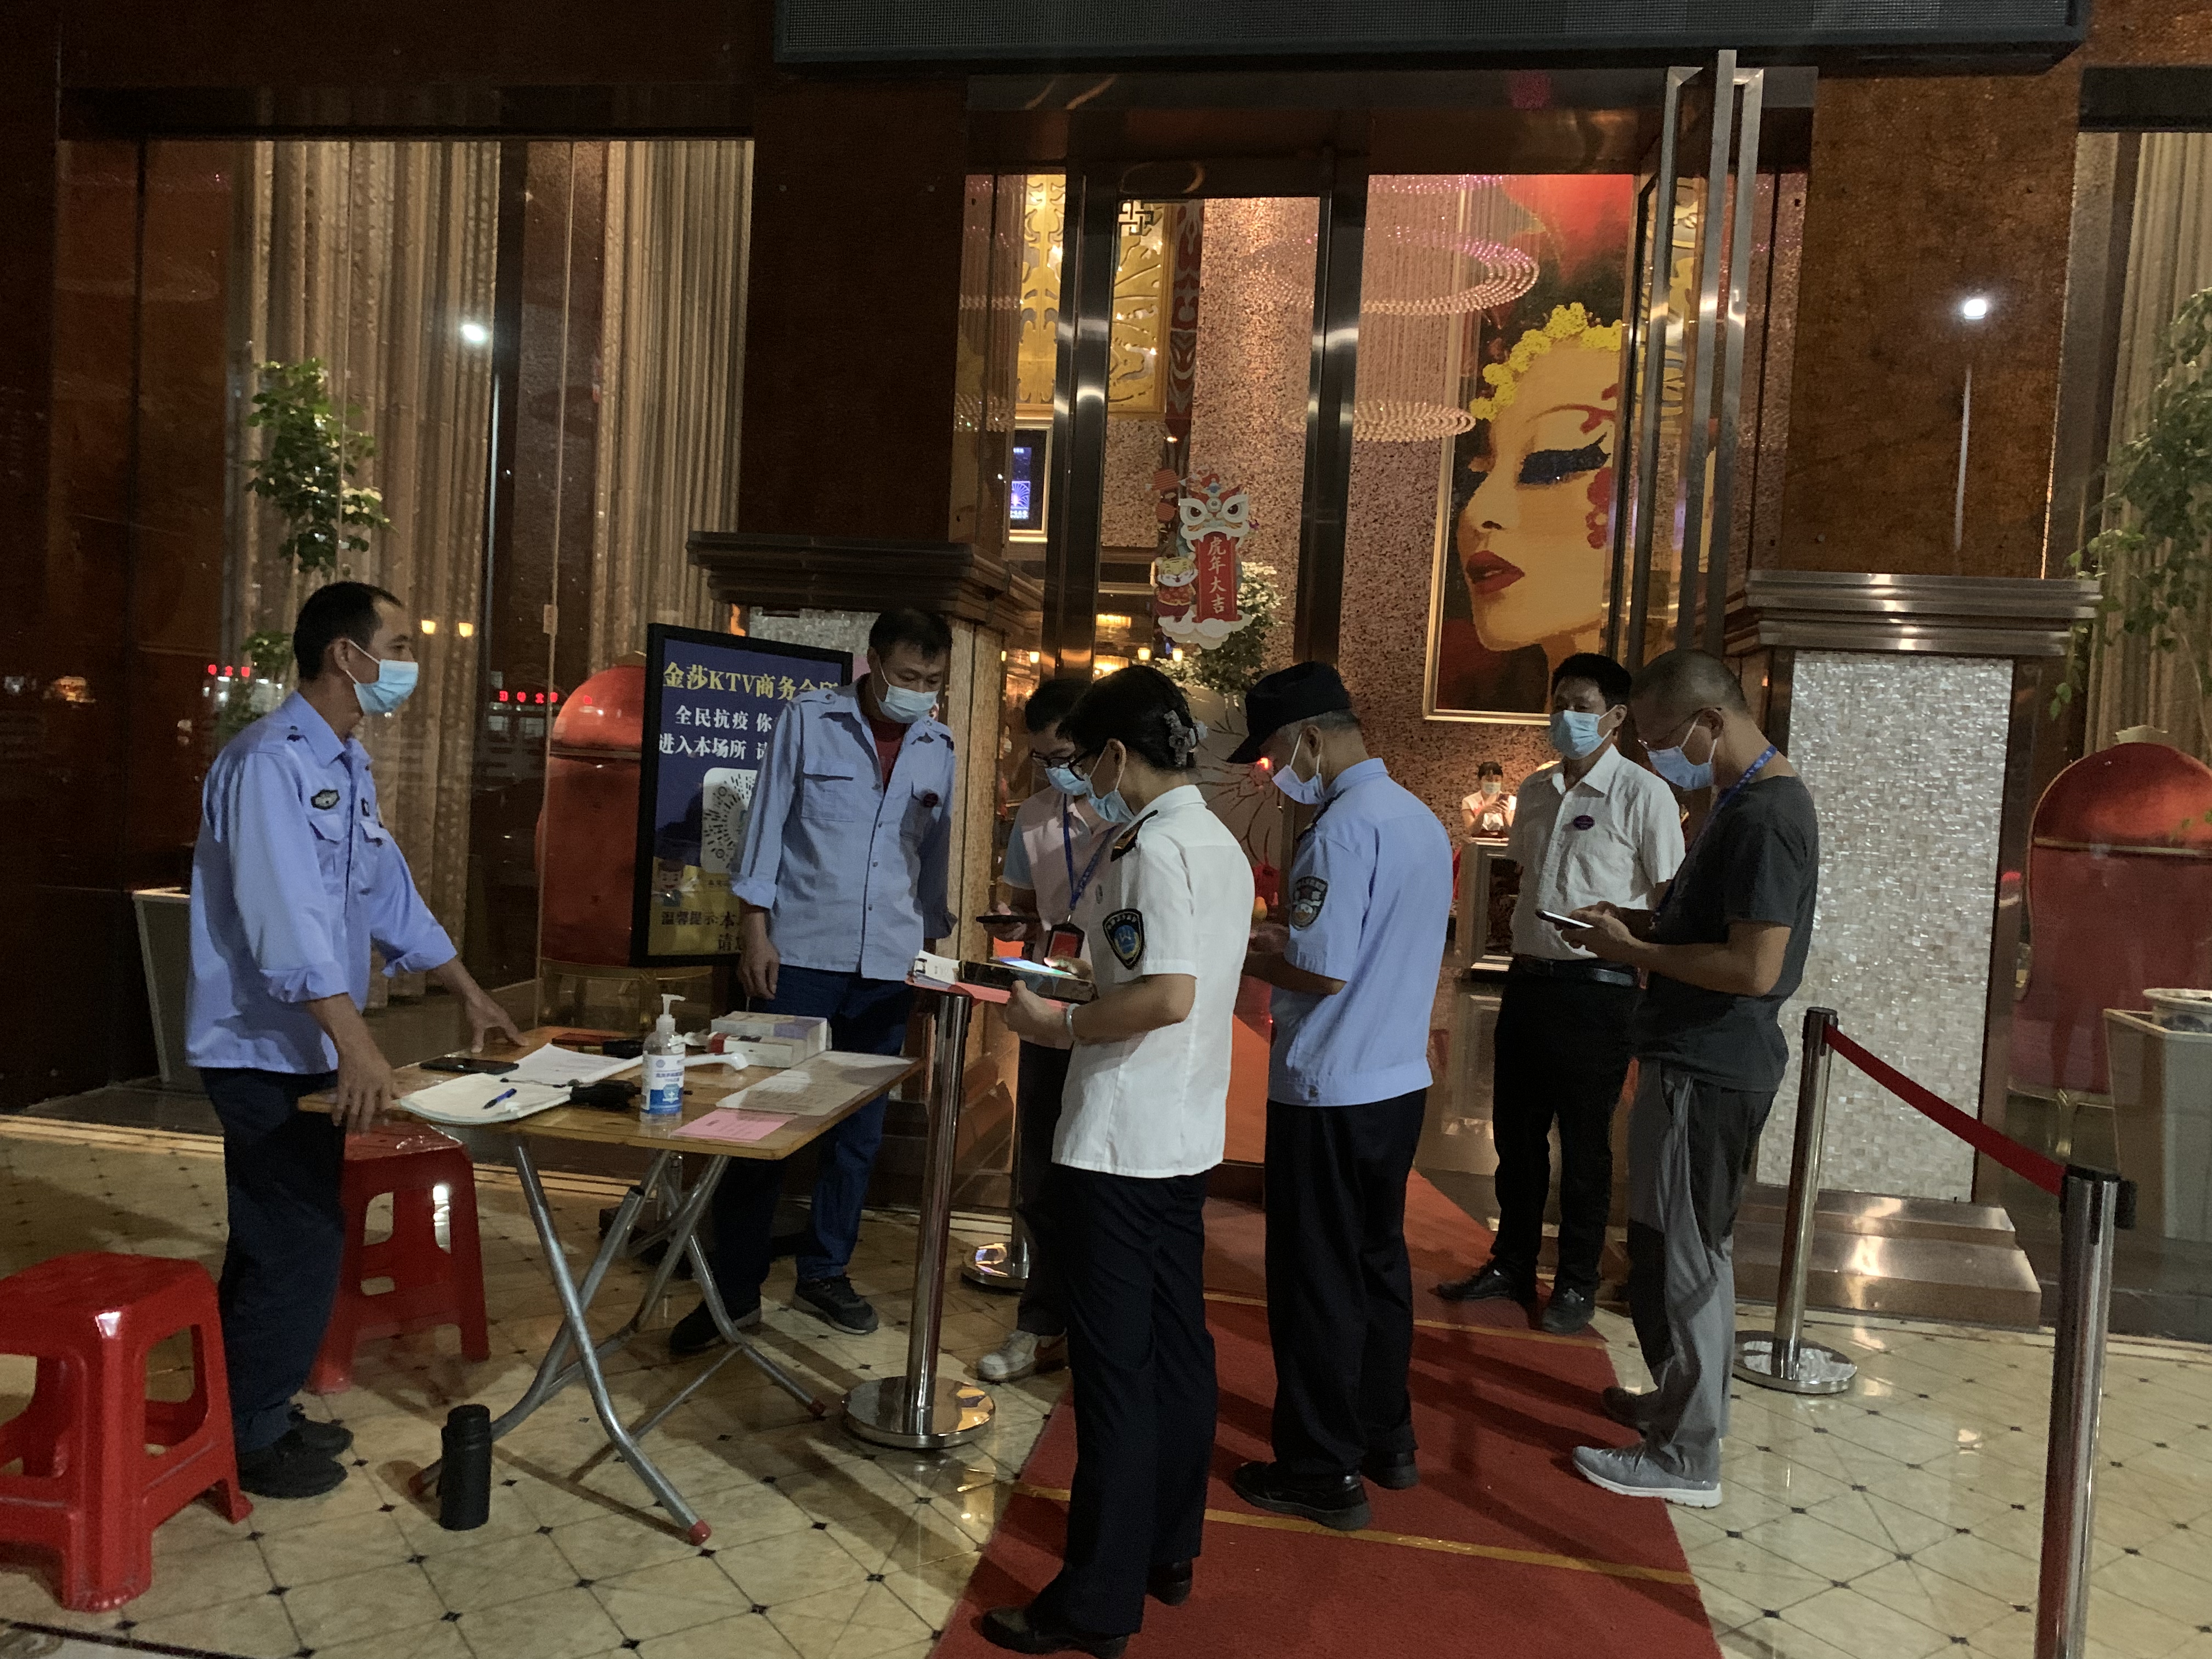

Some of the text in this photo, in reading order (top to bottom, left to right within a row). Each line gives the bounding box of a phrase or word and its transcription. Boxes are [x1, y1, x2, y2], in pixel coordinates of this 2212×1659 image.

[1207, 536, 1226, 613] 虎年大吉
[663, 662, 838, 701] 金莎KTV商务
[675, 704, 748, 730] 全民抗疫
[659, 732, 747, 760] 进入本场所
